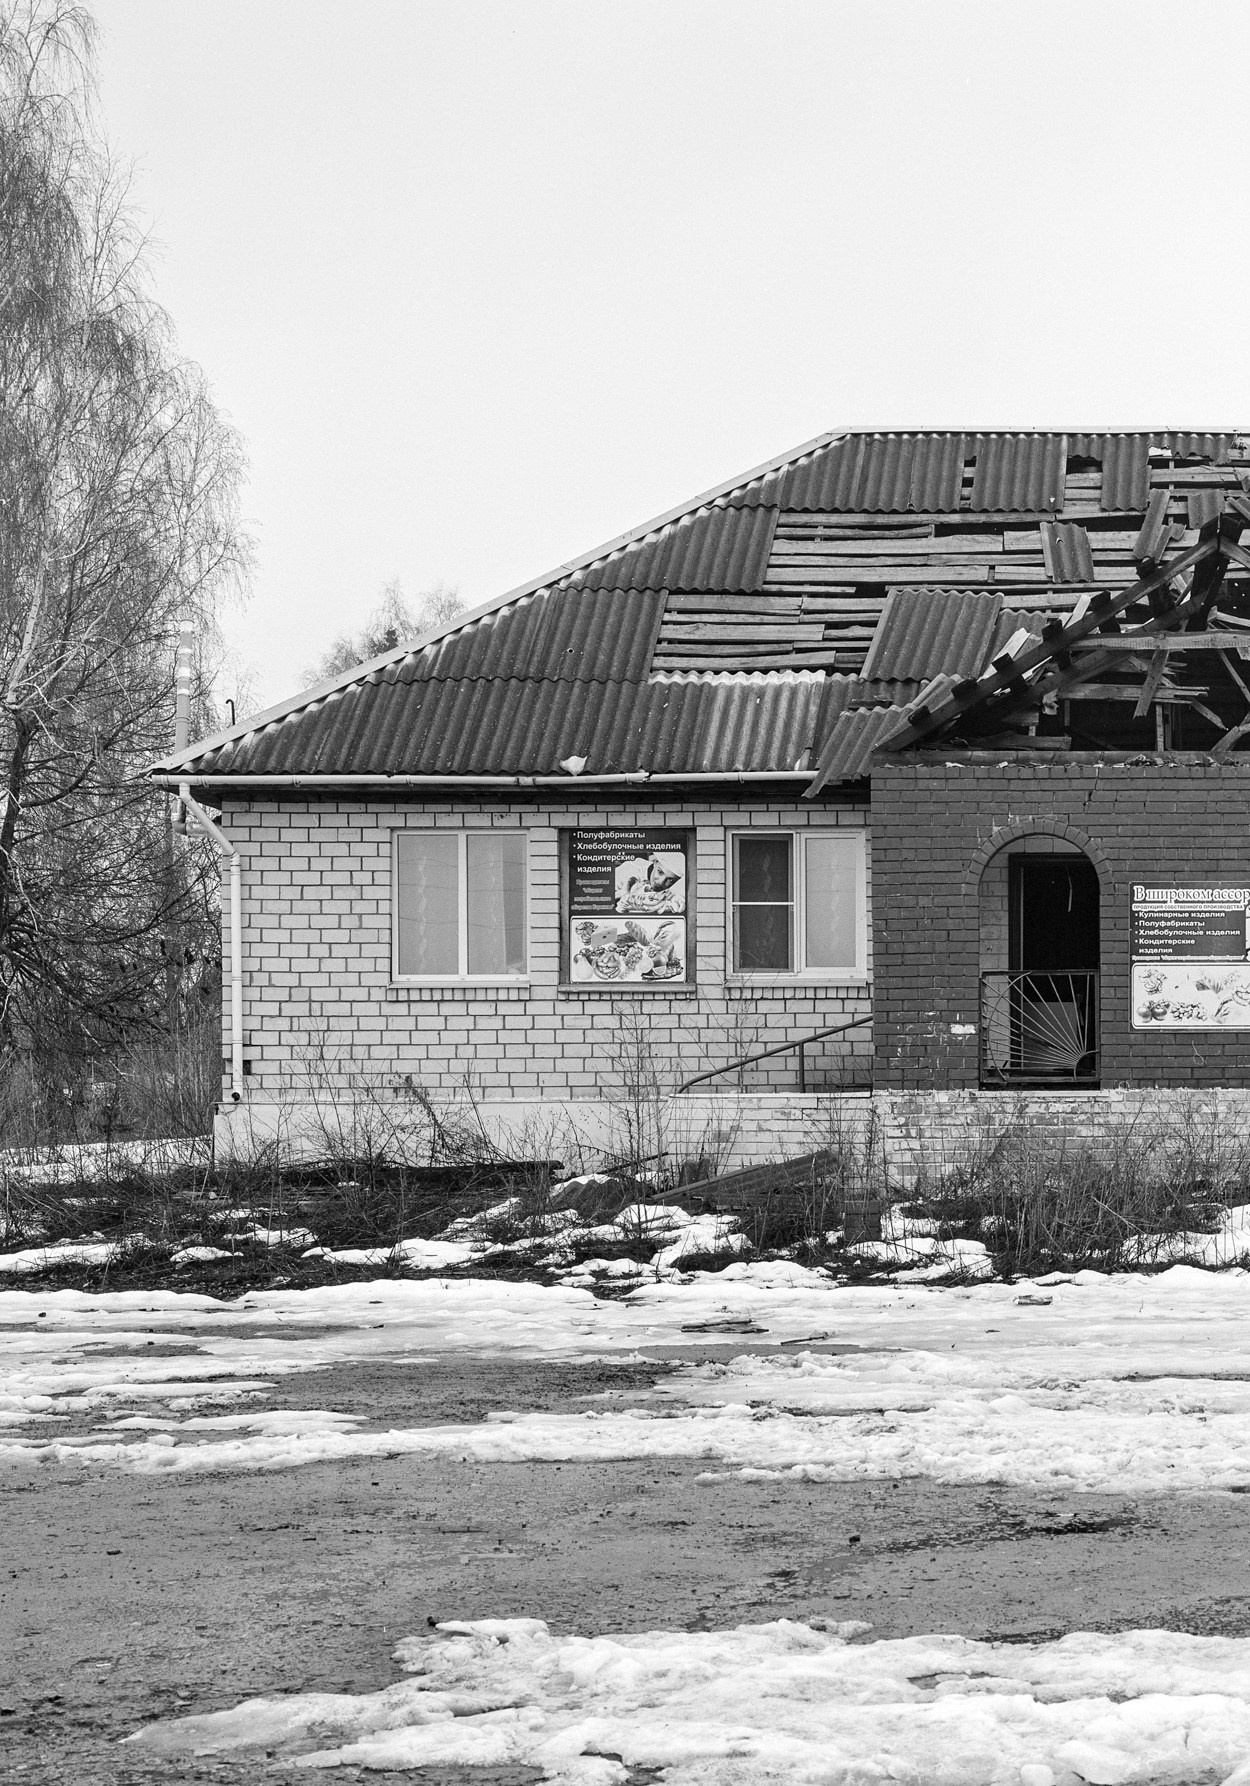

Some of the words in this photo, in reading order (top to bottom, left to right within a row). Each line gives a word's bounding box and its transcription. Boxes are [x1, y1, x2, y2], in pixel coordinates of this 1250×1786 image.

[577, 831, 646, 840] Полуфабрикаты
[577, 842, 644, 851] Хлебобулочные
[577, 854, 635, 862] Кондитерские
[1134, 886, 1145, 901] В
[1146, 888, 1212, 903] широком
[1138, 920, 1205, 928] Полуфабрикаты
